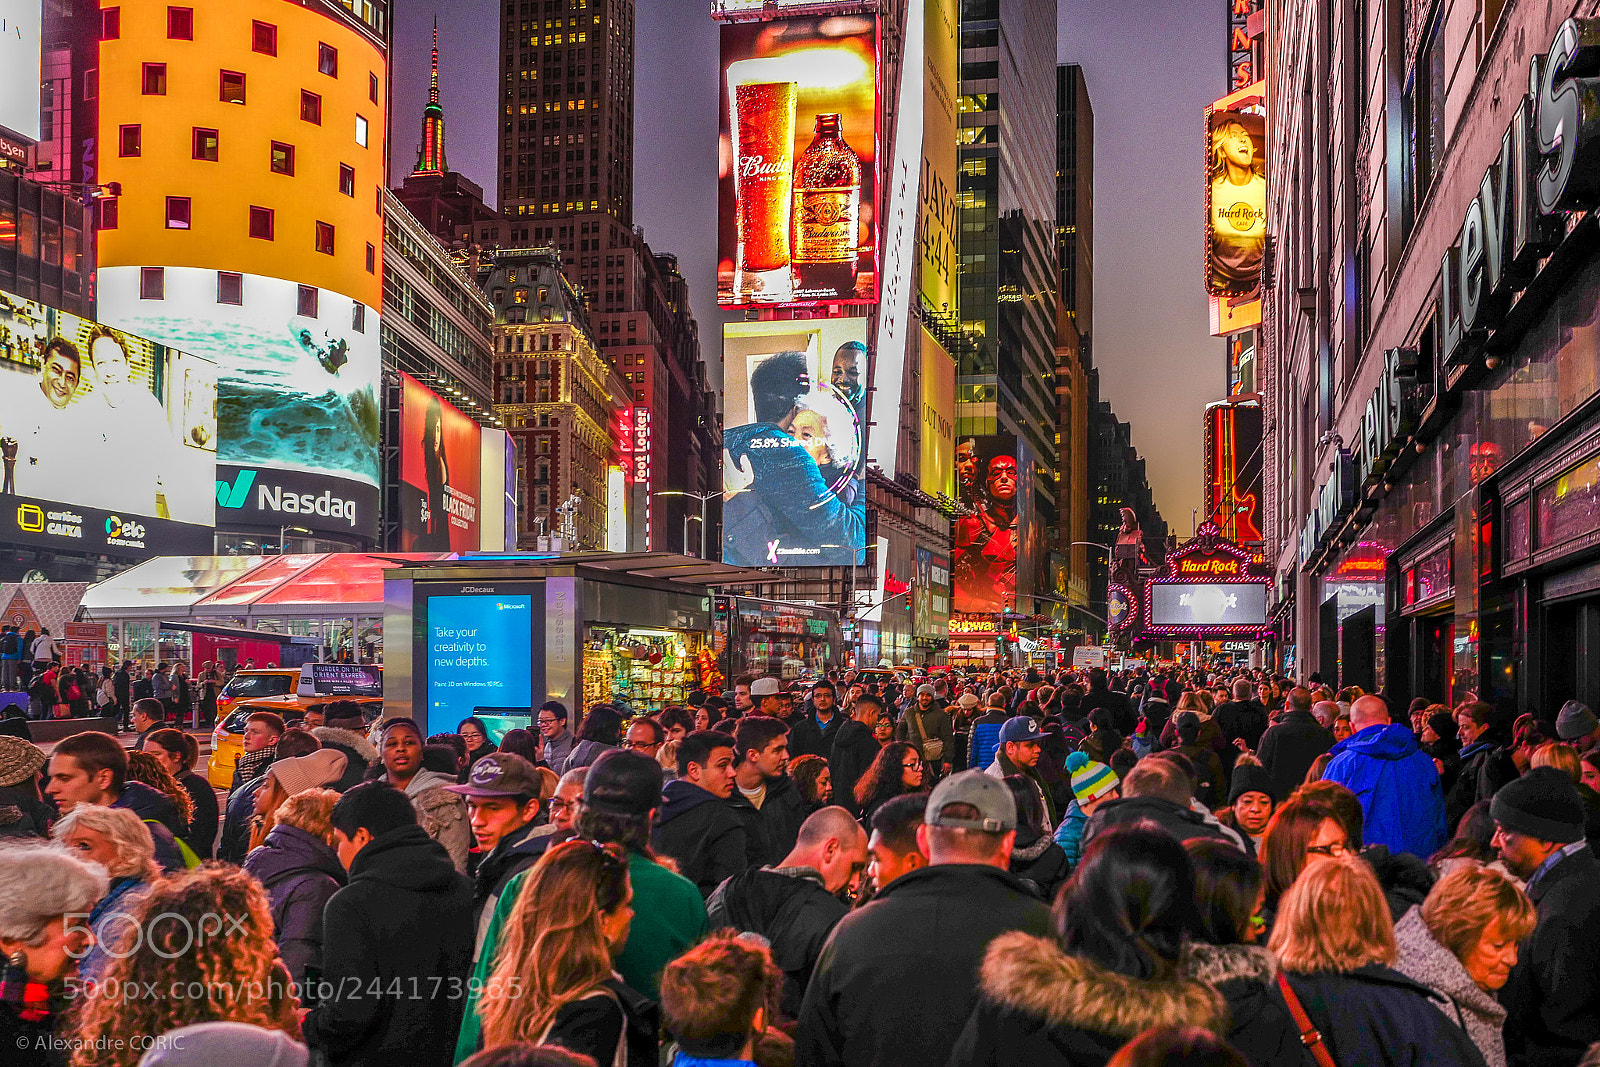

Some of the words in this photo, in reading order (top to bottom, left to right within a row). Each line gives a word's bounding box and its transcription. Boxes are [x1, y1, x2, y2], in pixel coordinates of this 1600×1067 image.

[1218, 206, 1241, 218] Hard
[1242, 208, 1264, 220] Rock
[923, 402, 936, 429] OUT
[938, 414, 952, 441] NOW
[634, 410, 647, 452] Locker
[634, 455, 647, 483] Foot
[258, 484, 356, 527] Nasdaq
[1181, 560, 1210, 572] Hard
[1210, 560, 1238, 574] Rock
[434, 627, 454, 637] Take
[456, 628, 477, 640] your
[434, 642, 474, 654] creativity
[477, 643, 487, 652] to
[434, 658, 454, 666] new
[456, 656, 490, 669] depths.
